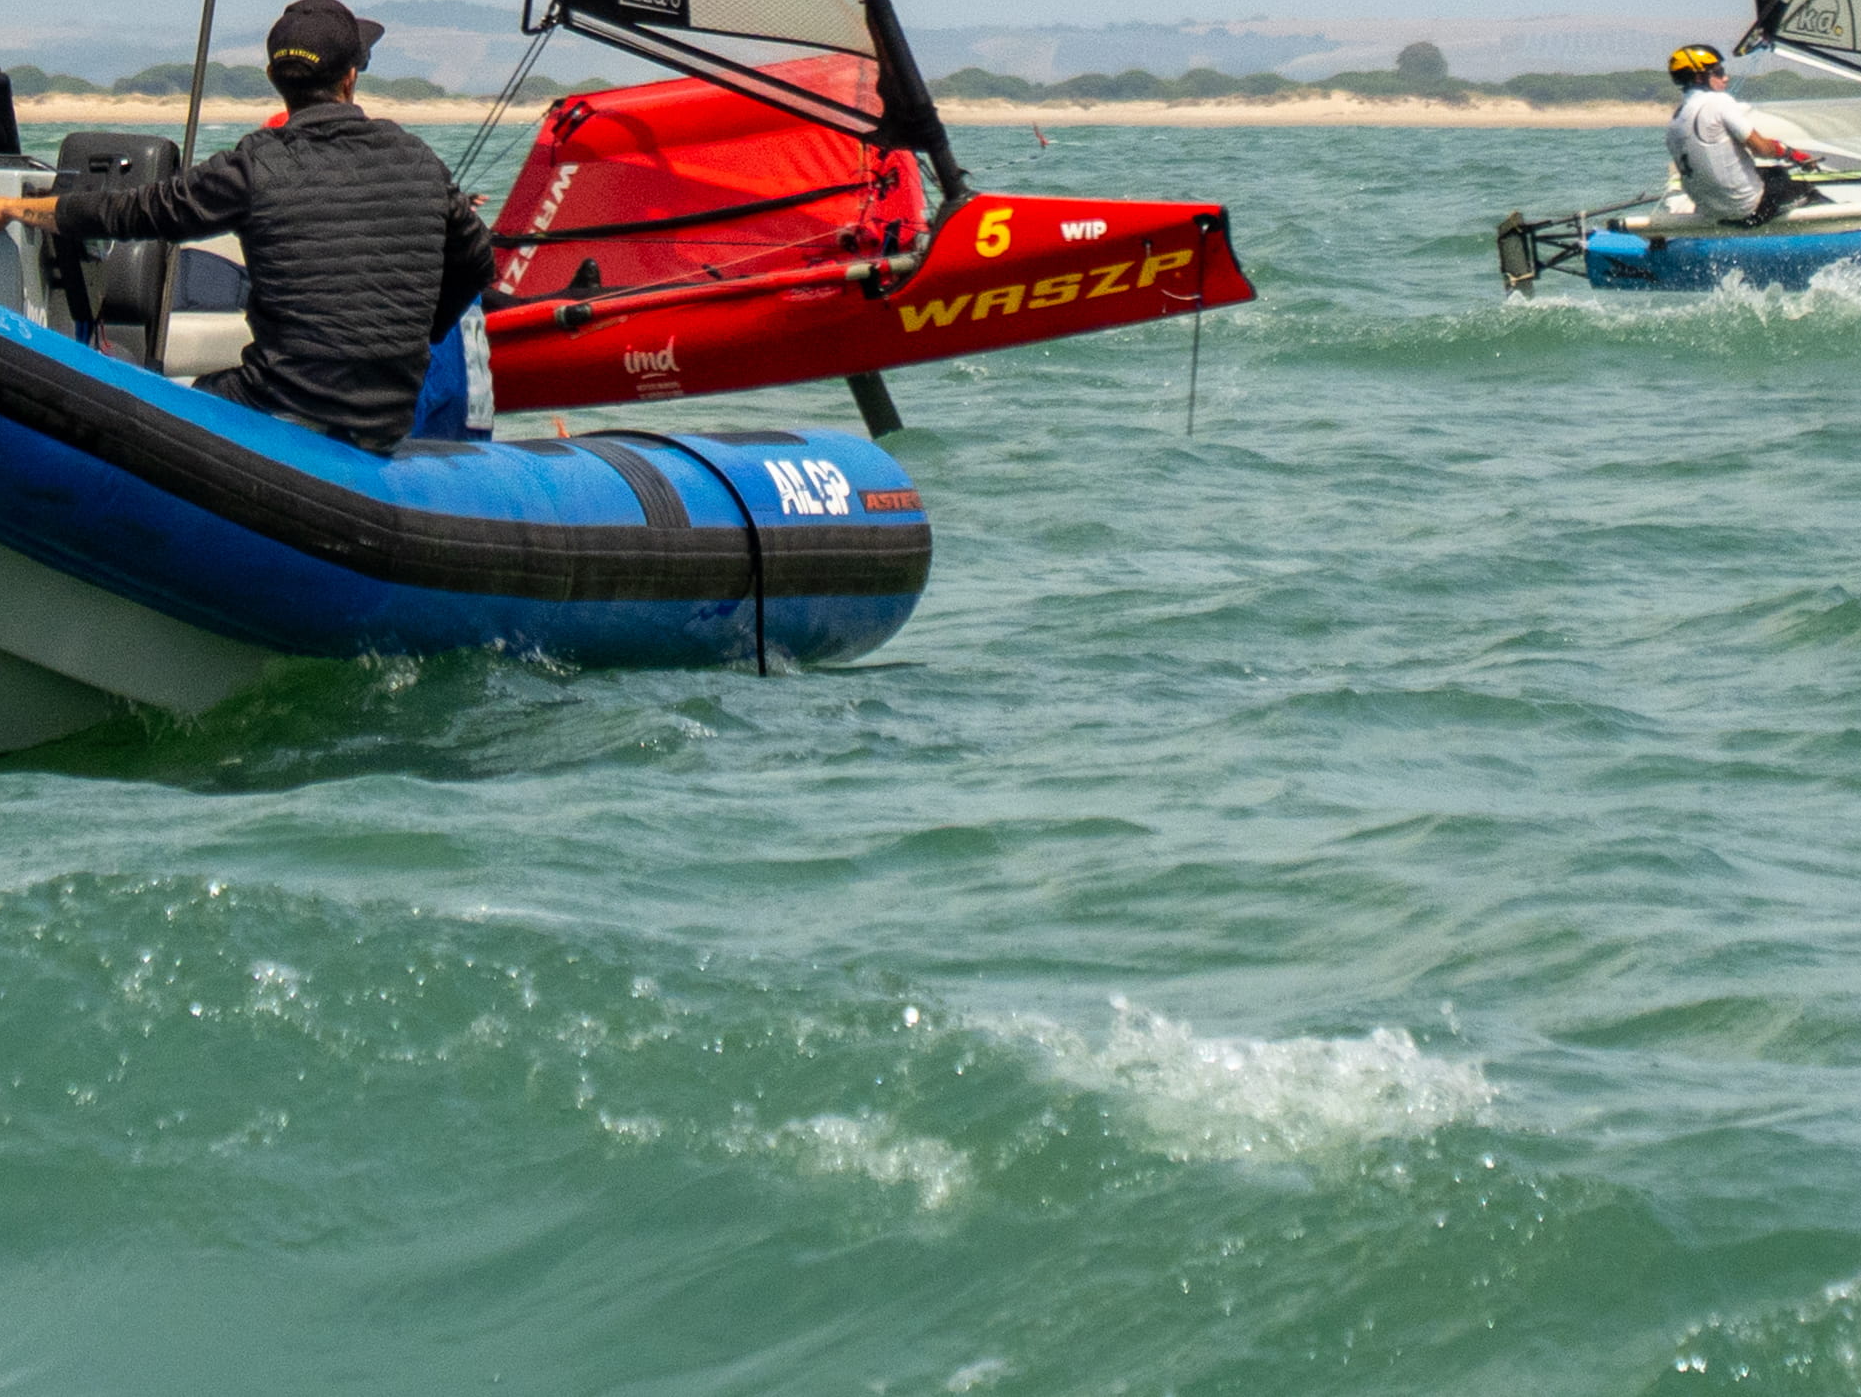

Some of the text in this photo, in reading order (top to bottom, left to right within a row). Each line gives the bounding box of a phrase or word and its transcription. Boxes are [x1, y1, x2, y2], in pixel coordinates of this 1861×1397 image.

[974, 207, 1014, 258] 5
[1060, 218, 1108, 242] WIP
[898, 248, 1194, 333] WASZP
[623, 334, 681, 375] imd
